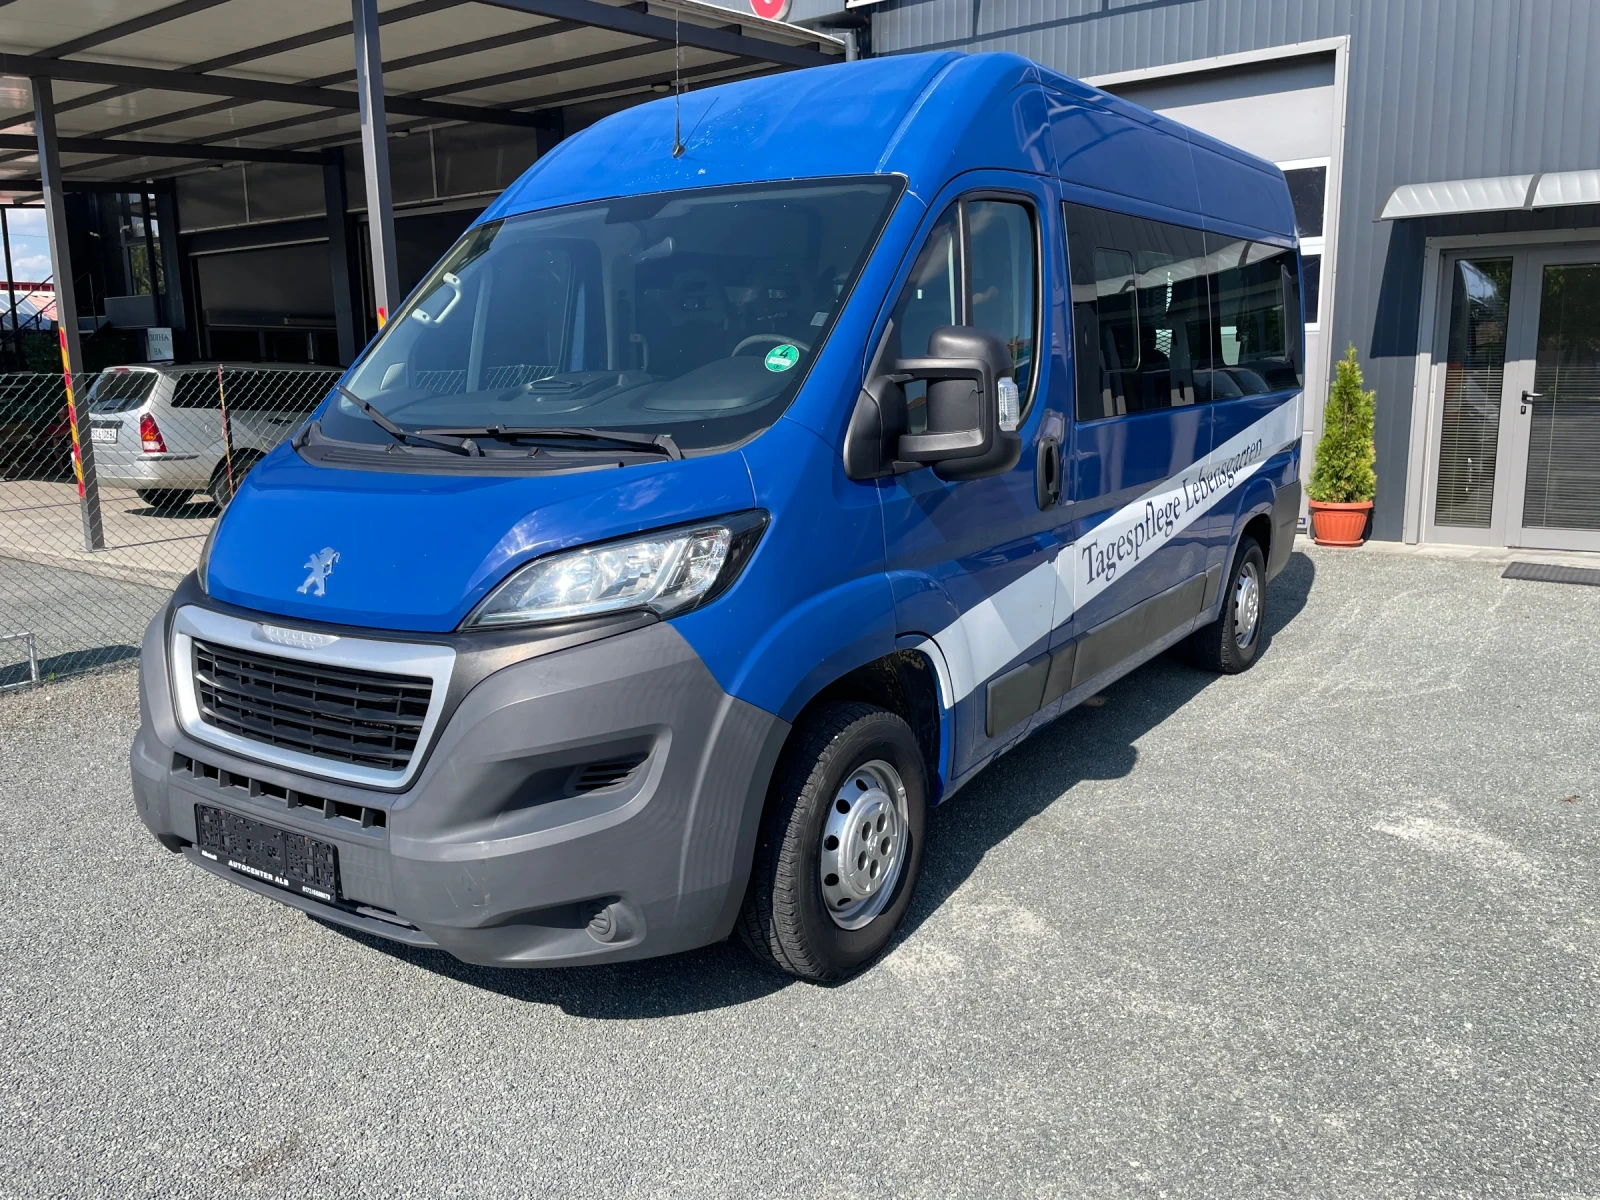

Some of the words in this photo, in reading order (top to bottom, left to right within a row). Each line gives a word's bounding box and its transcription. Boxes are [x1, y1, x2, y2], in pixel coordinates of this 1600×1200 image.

[779, 346, 791, 358] 4
[1082, 496, 1181, 585] Tagespflege
[1182, 438, 1262, 513] Lebensgarten
[268, 627, 323, 644] PEUGEOT
[228, 859, 273, 881] AUTOCENTER
